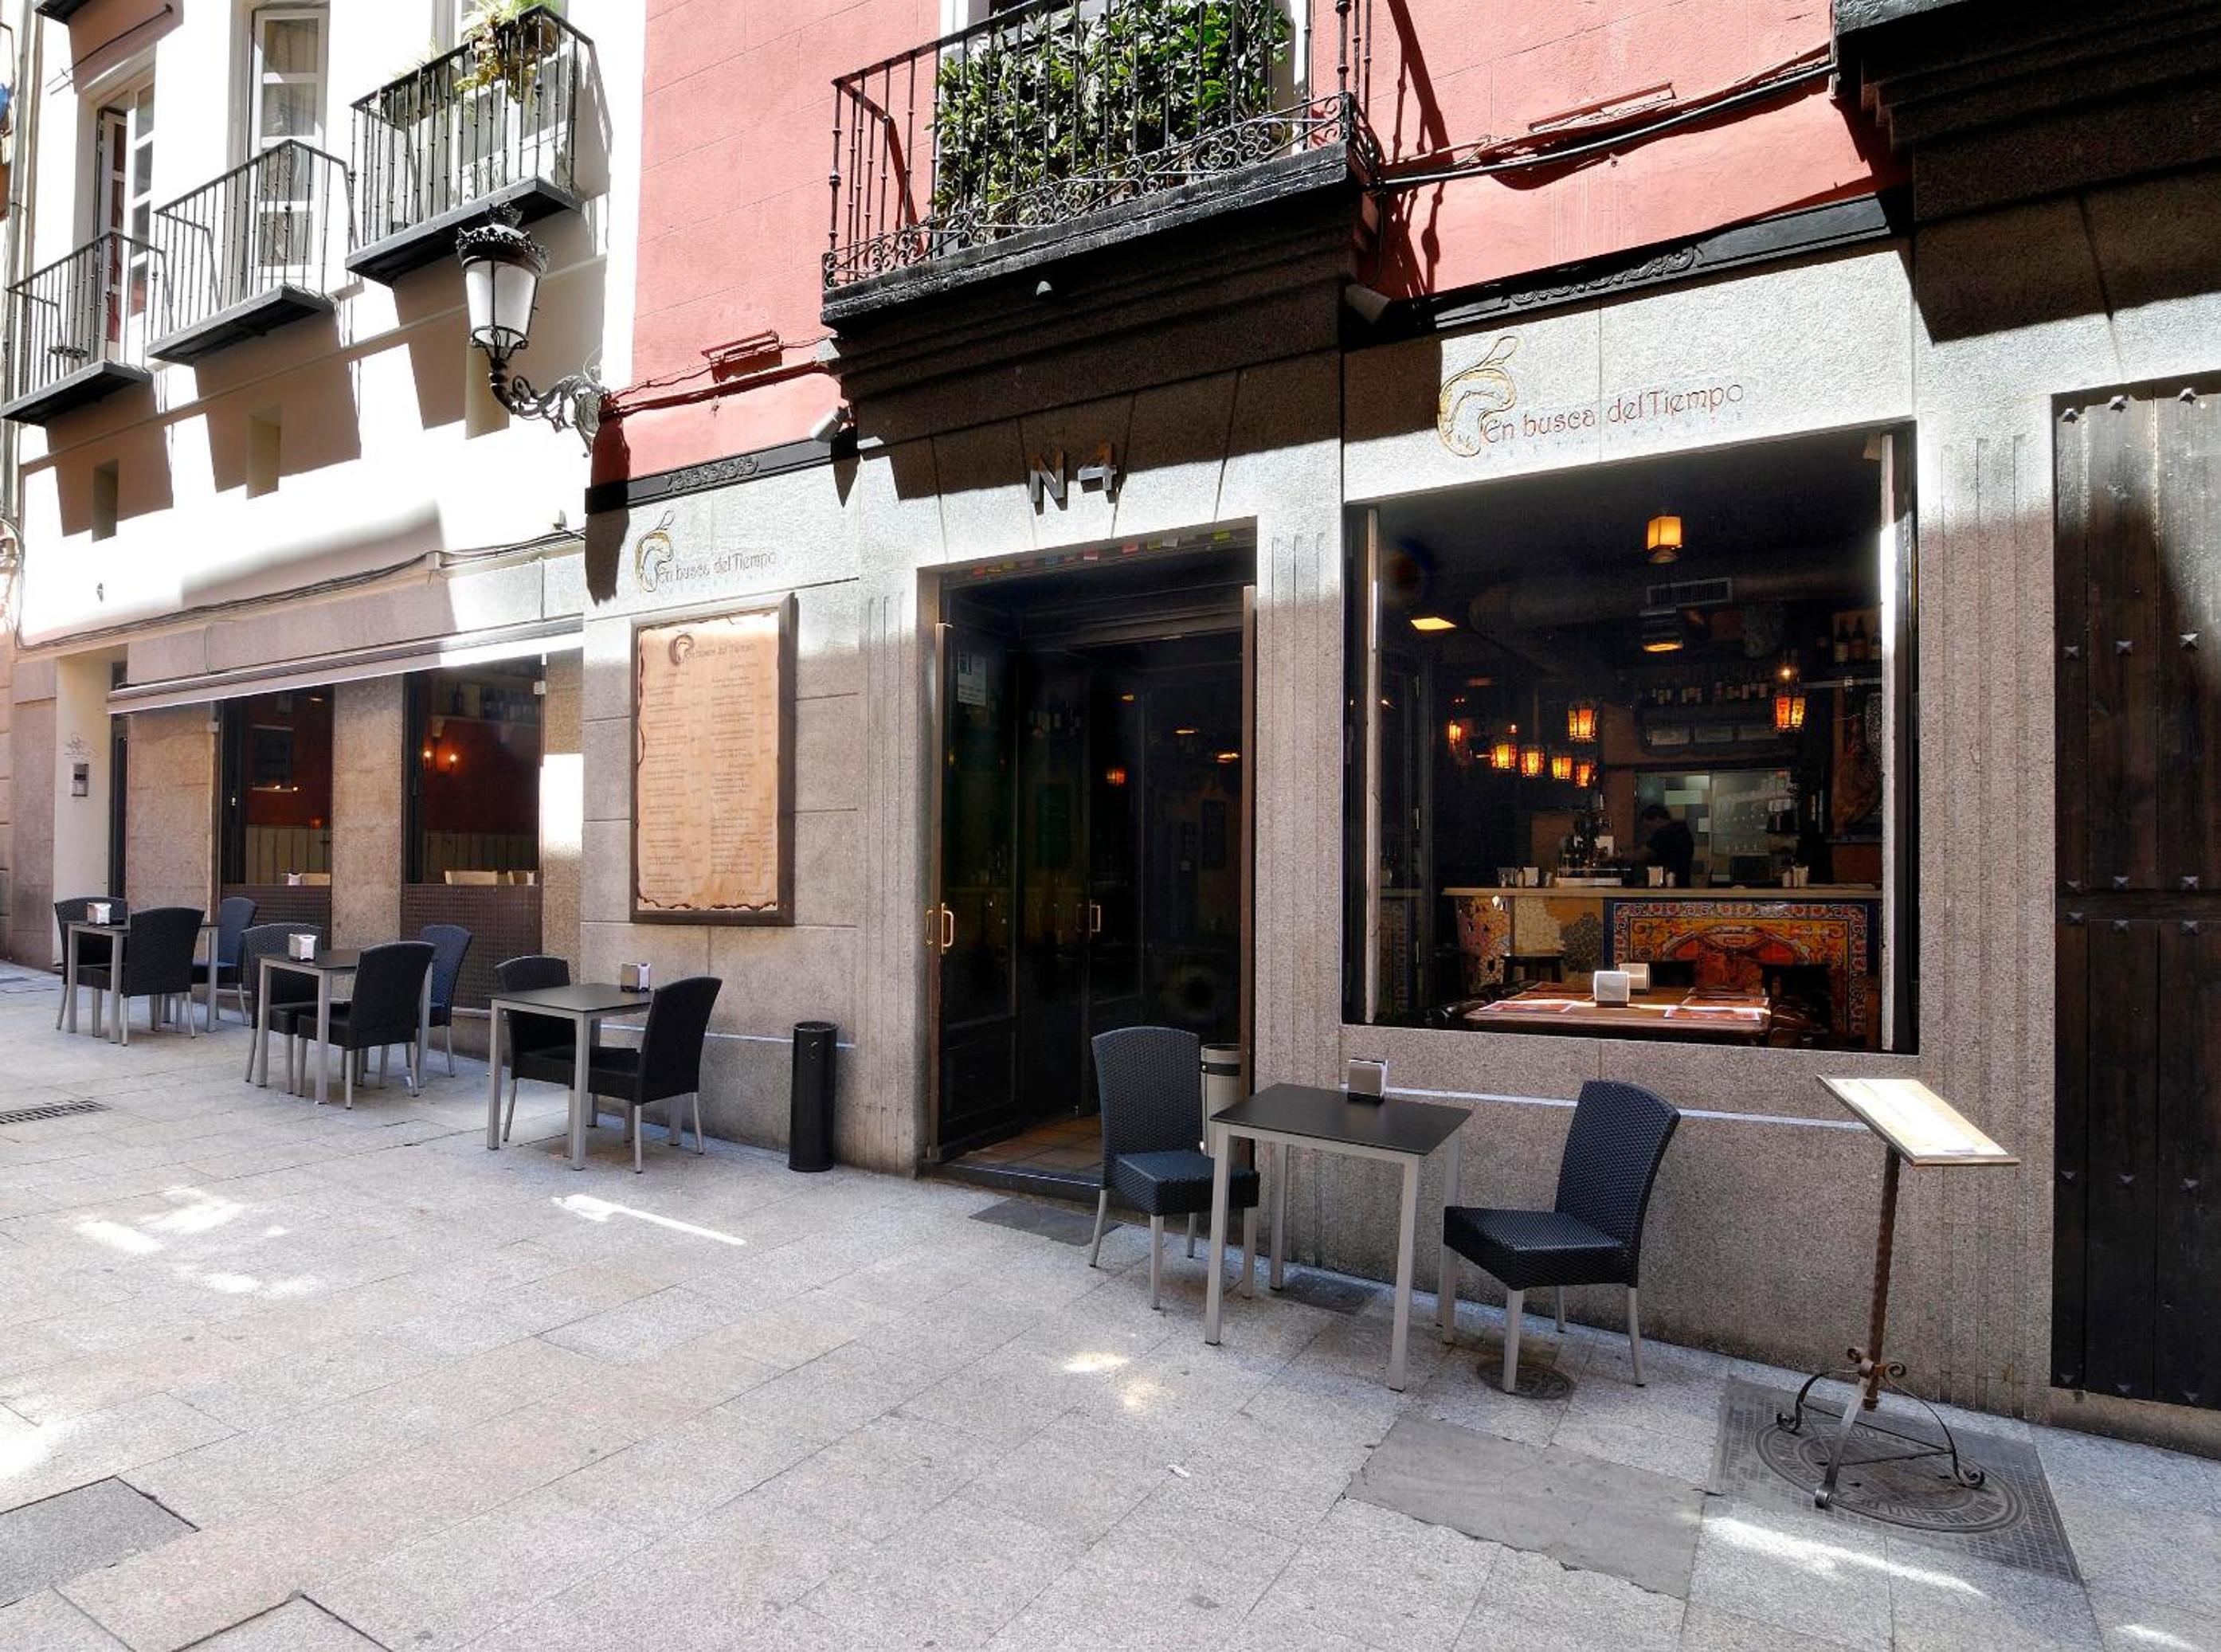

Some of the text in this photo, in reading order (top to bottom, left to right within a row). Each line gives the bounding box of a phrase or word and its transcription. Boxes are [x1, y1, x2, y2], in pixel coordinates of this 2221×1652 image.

[1523, 412, 1596, 437] busca
[1607, 397, 1644, 425] del
[1647, 383, 1744, 416] Tiempo
